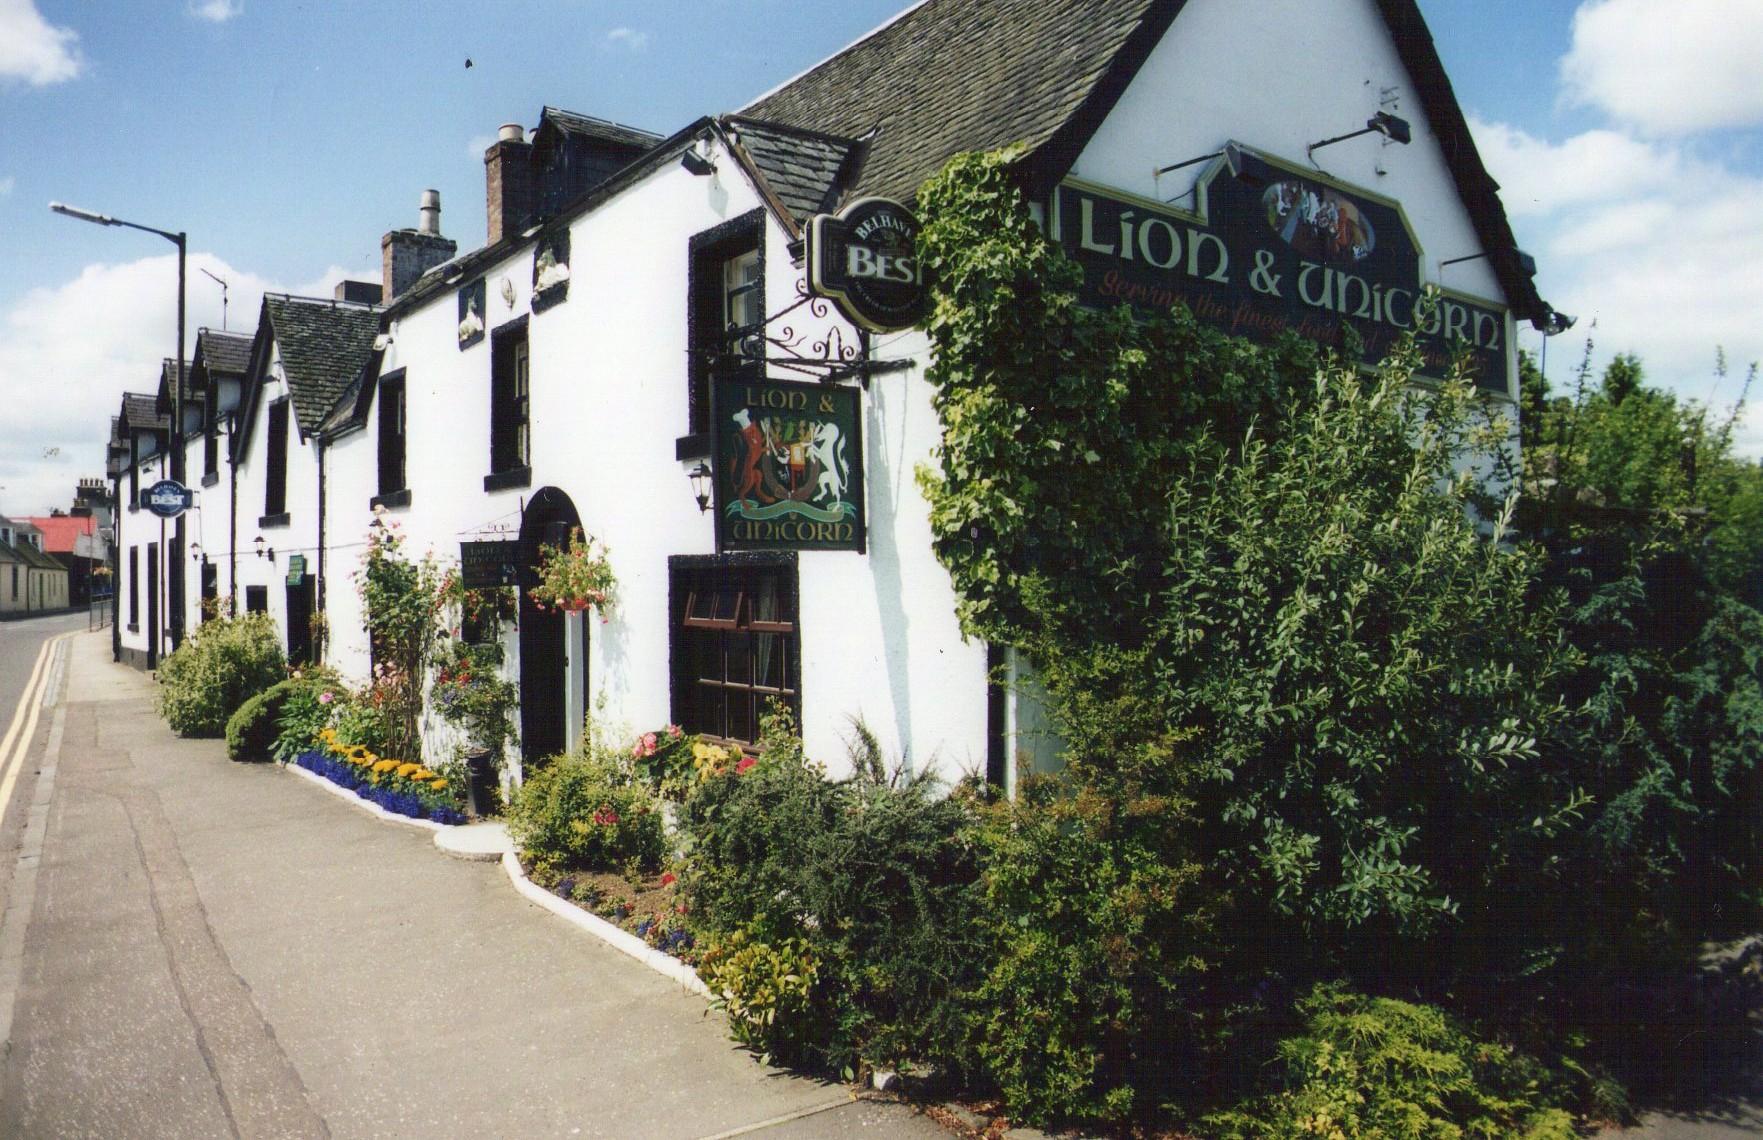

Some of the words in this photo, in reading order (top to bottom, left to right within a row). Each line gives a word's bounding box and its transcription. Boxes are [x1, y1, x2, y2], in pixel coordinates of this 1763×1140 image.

[848, 245, 925, 287] BEST
[1249, 249, 1285, 297] &
[819, 392, 836, 414] &
